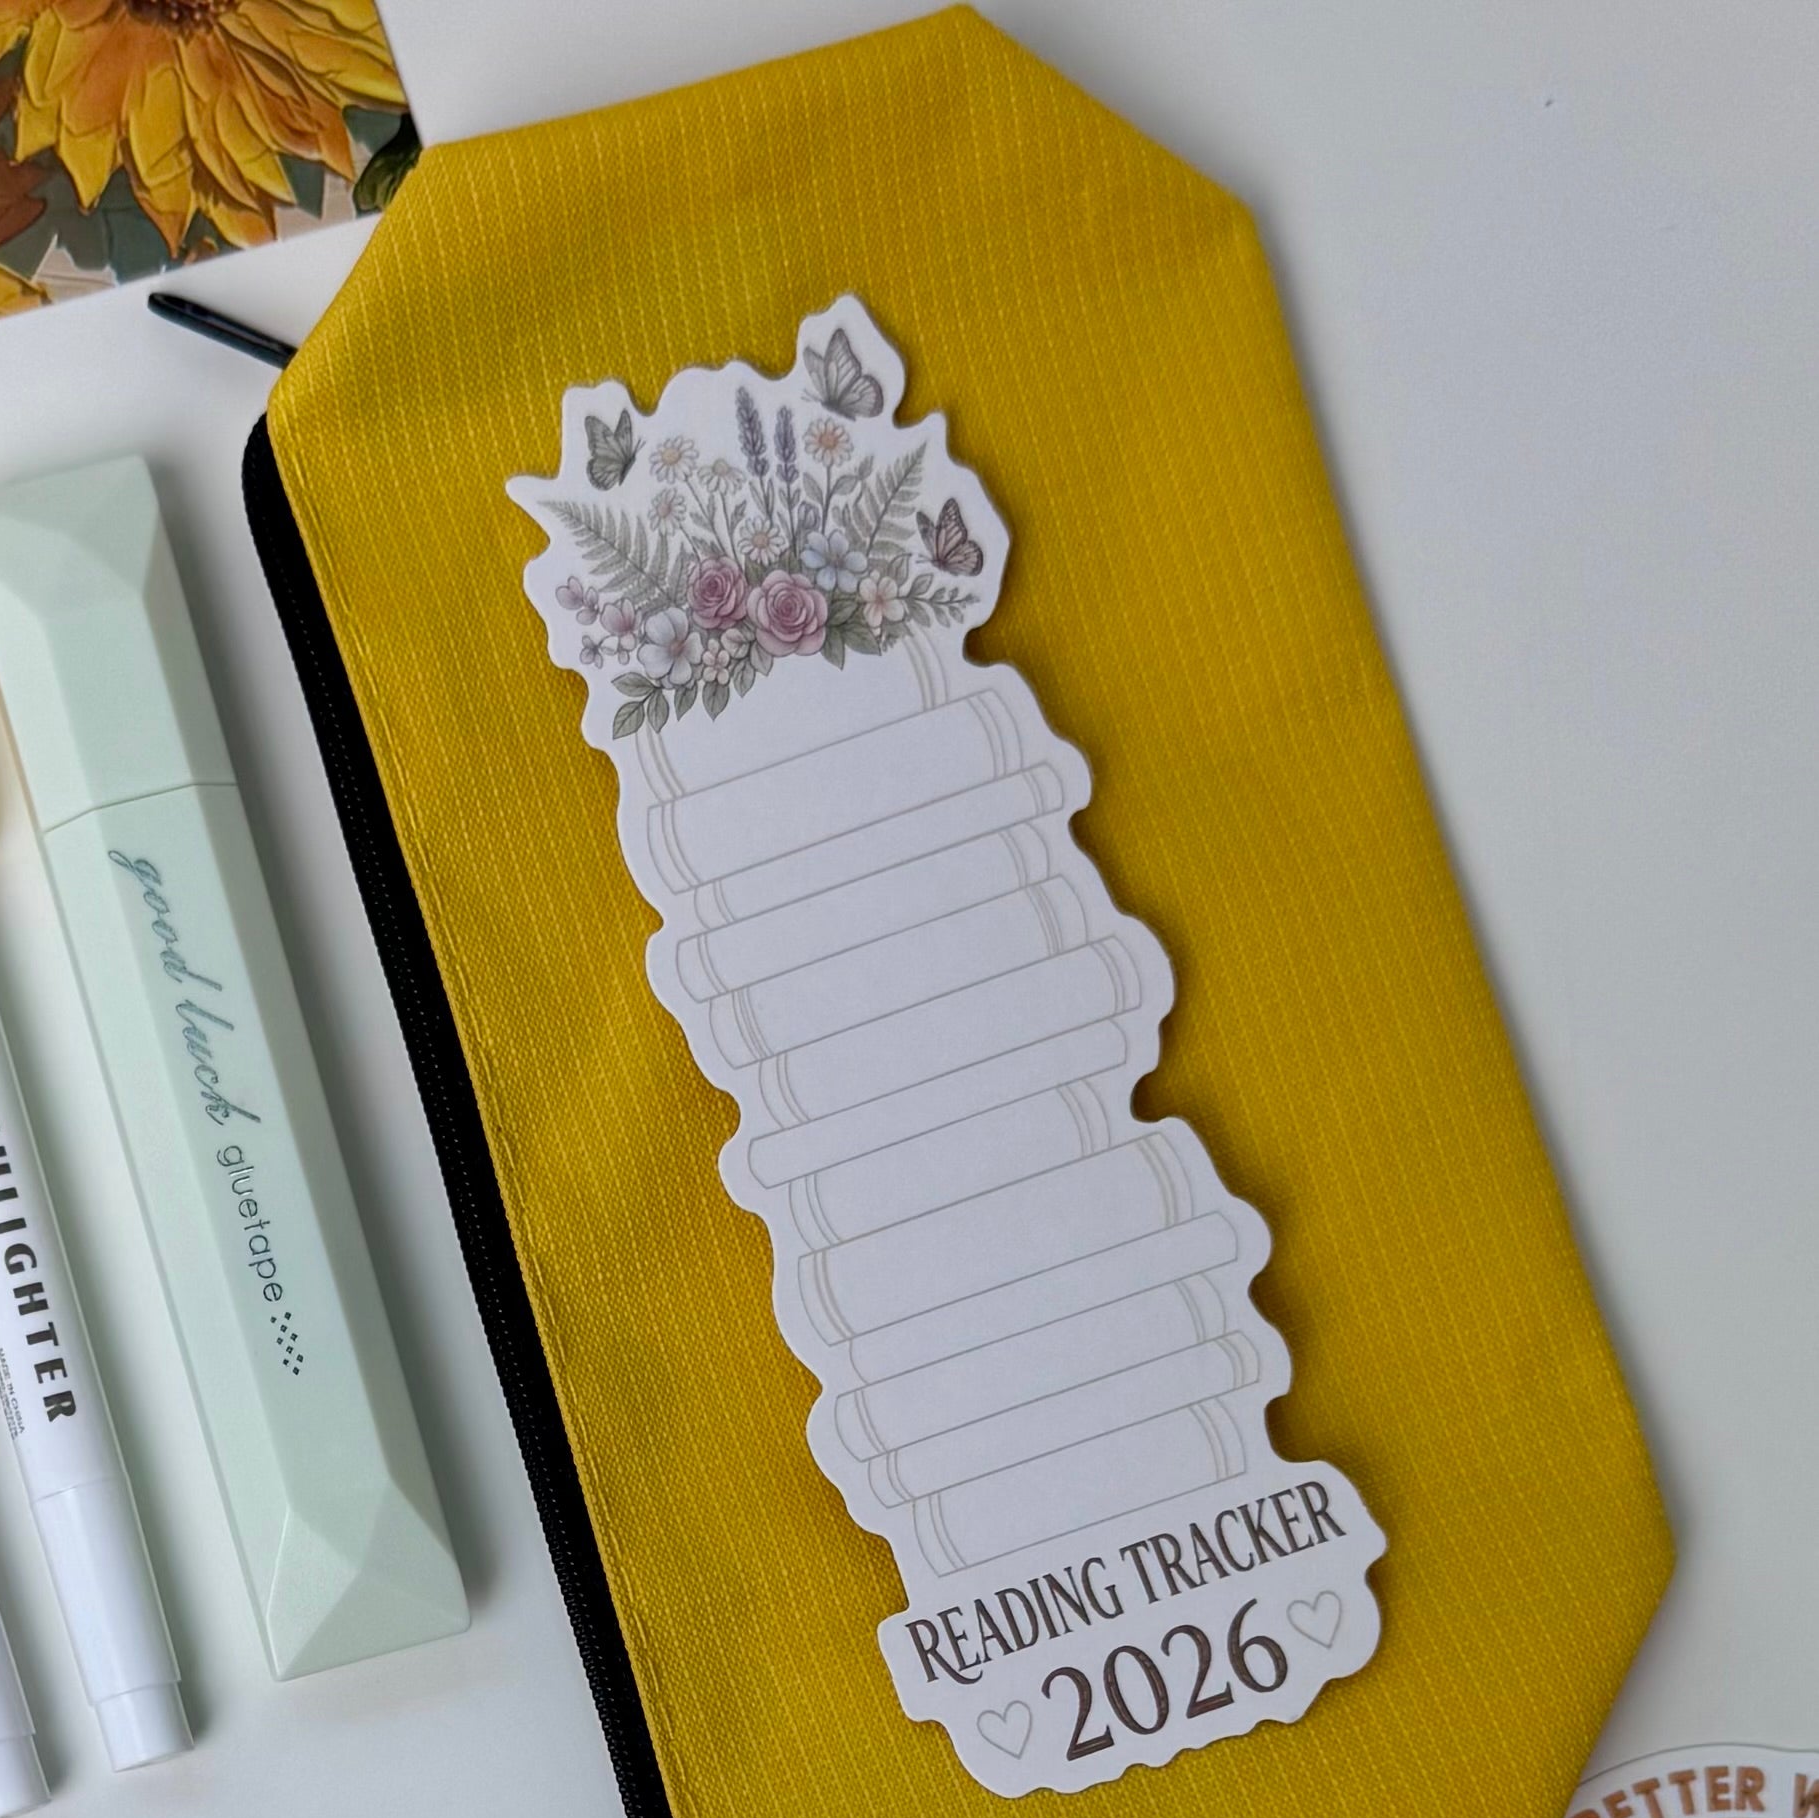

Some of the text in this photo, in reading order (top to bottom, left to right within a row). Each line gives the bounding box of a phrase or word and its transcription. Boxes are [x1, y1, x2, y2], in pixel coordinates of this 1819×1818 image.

[107, 849, 261, 1126] good luck
[215, 1143, 283, 1303] gluetape
[905, 1480, 1347, 1685] READING TRACKER
[1041, 1597, 1289, 1762] 2026
